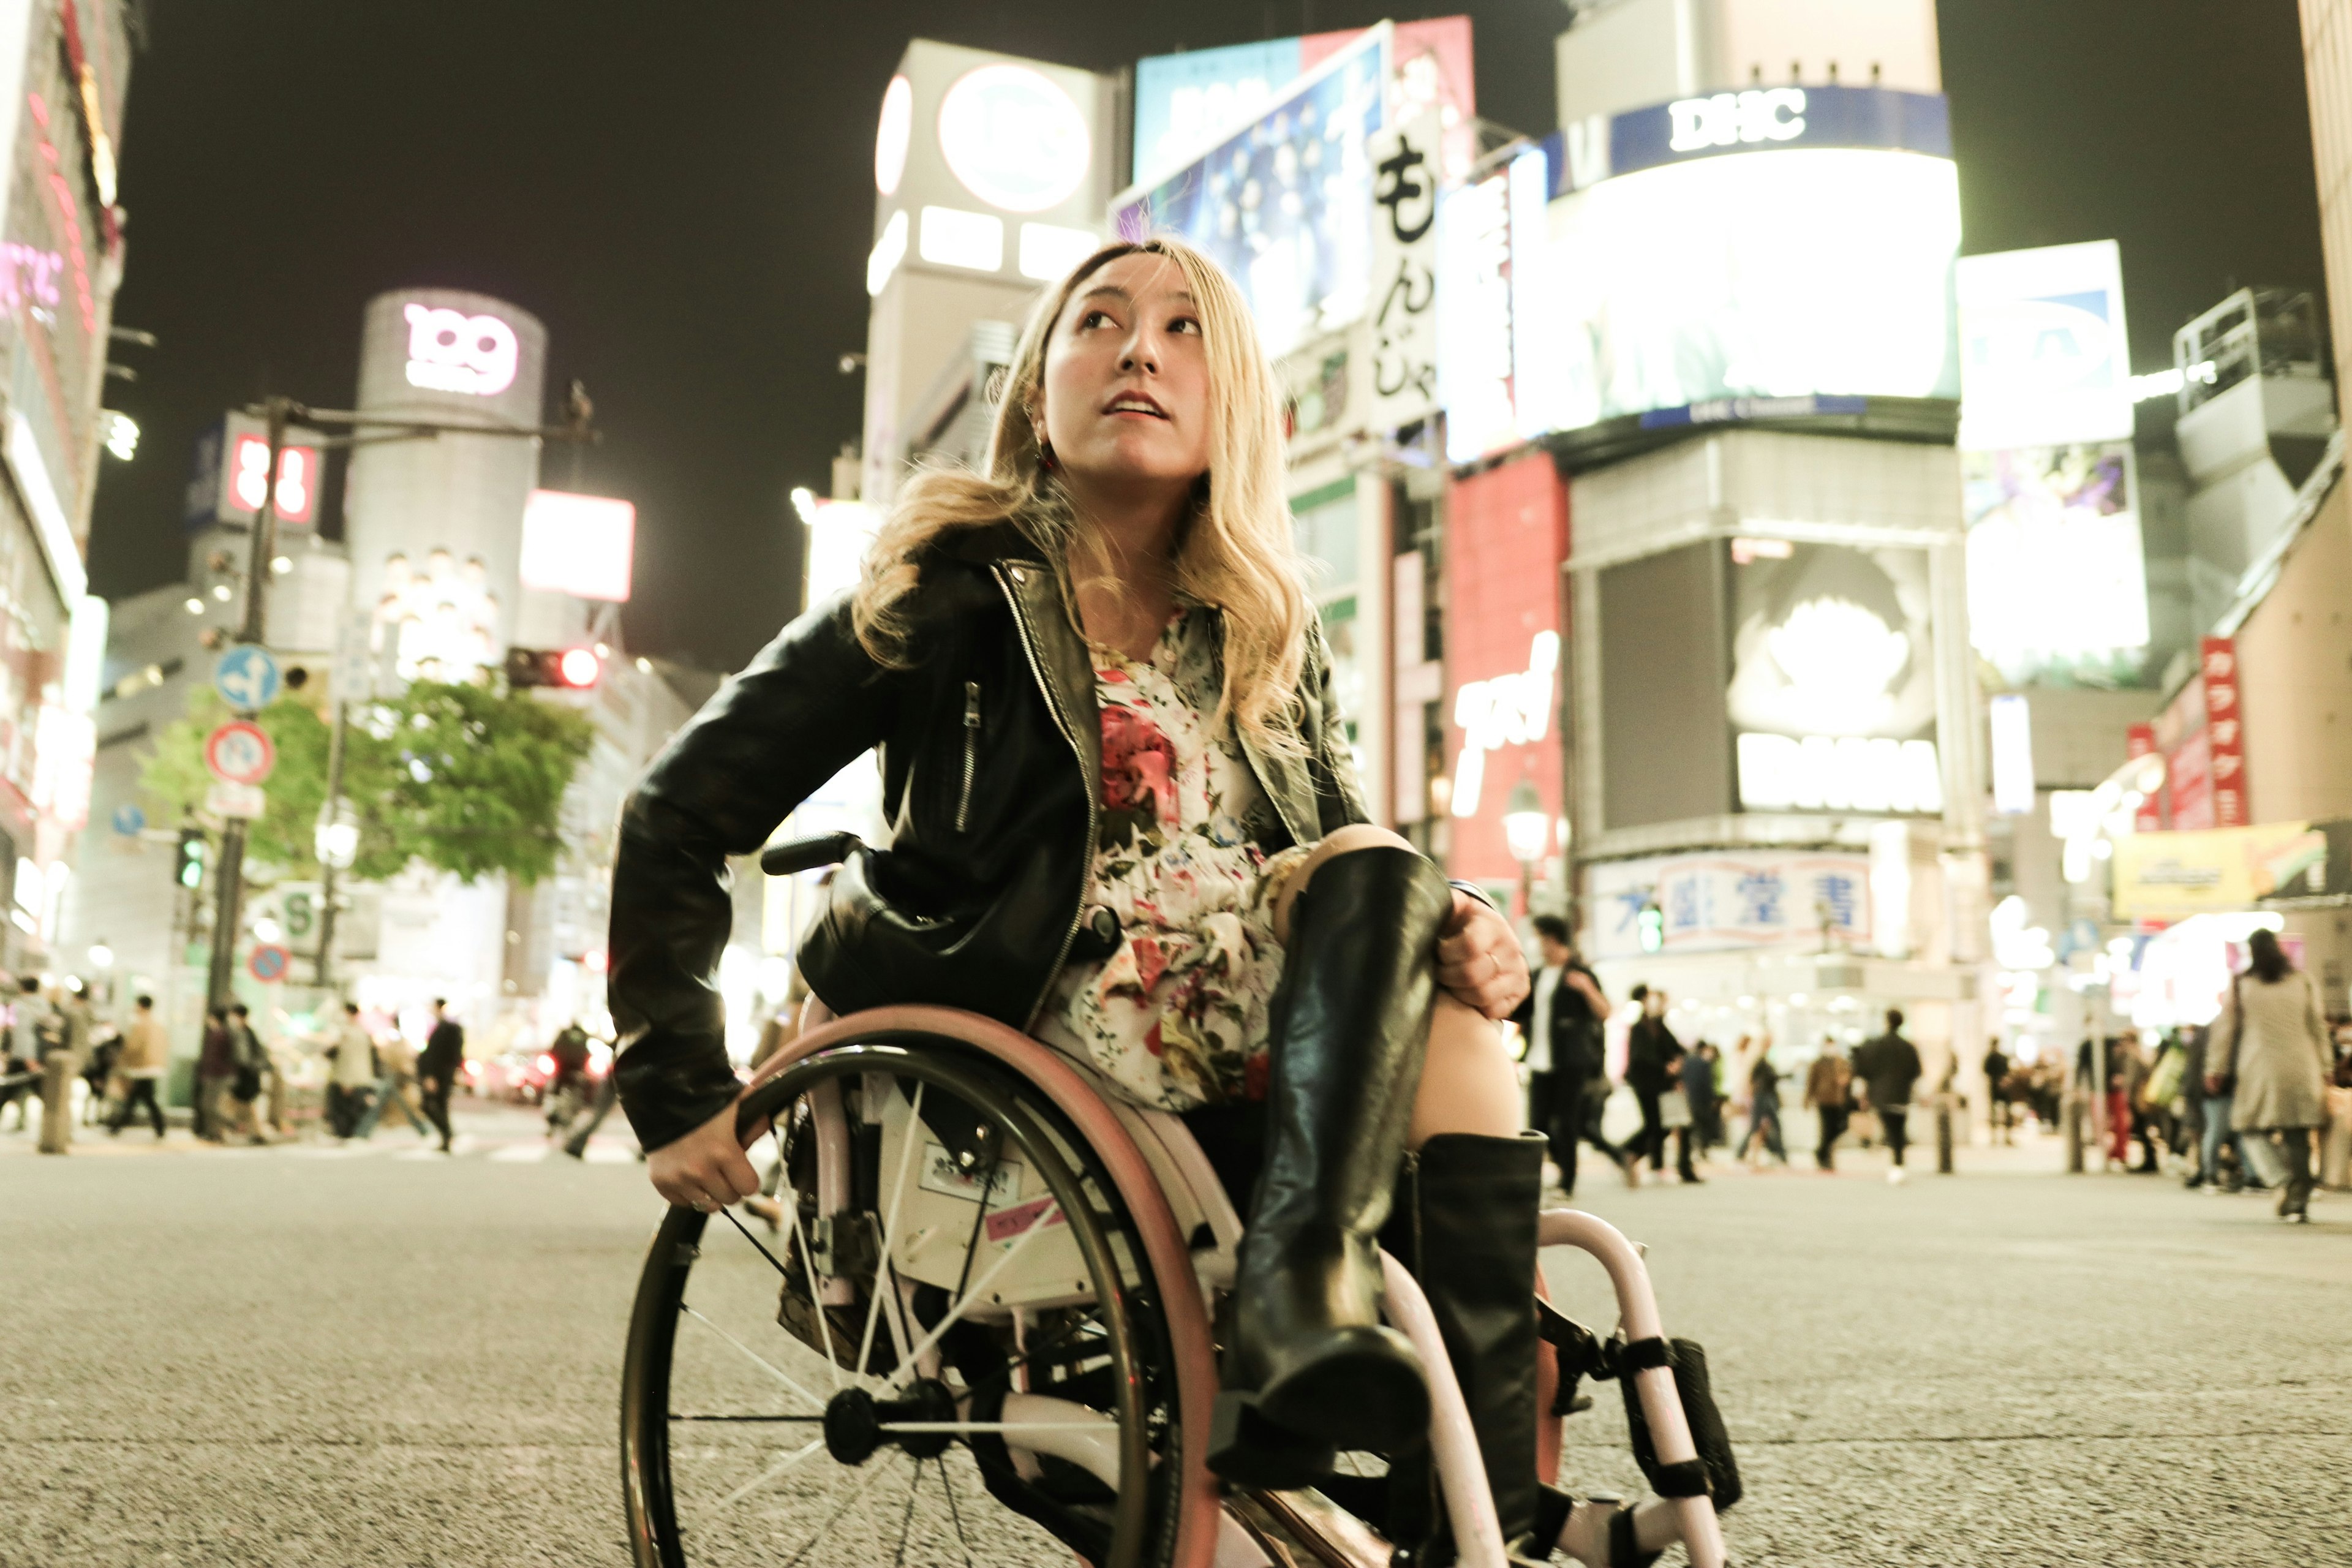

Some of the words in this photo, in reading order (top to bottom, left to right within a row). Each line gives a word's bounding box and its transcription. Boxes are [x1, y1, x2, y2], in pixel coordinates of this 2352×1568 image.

[1668, 88, 1806, 152] DHC
[1375, 133, 1436, 399] もんじゃ
